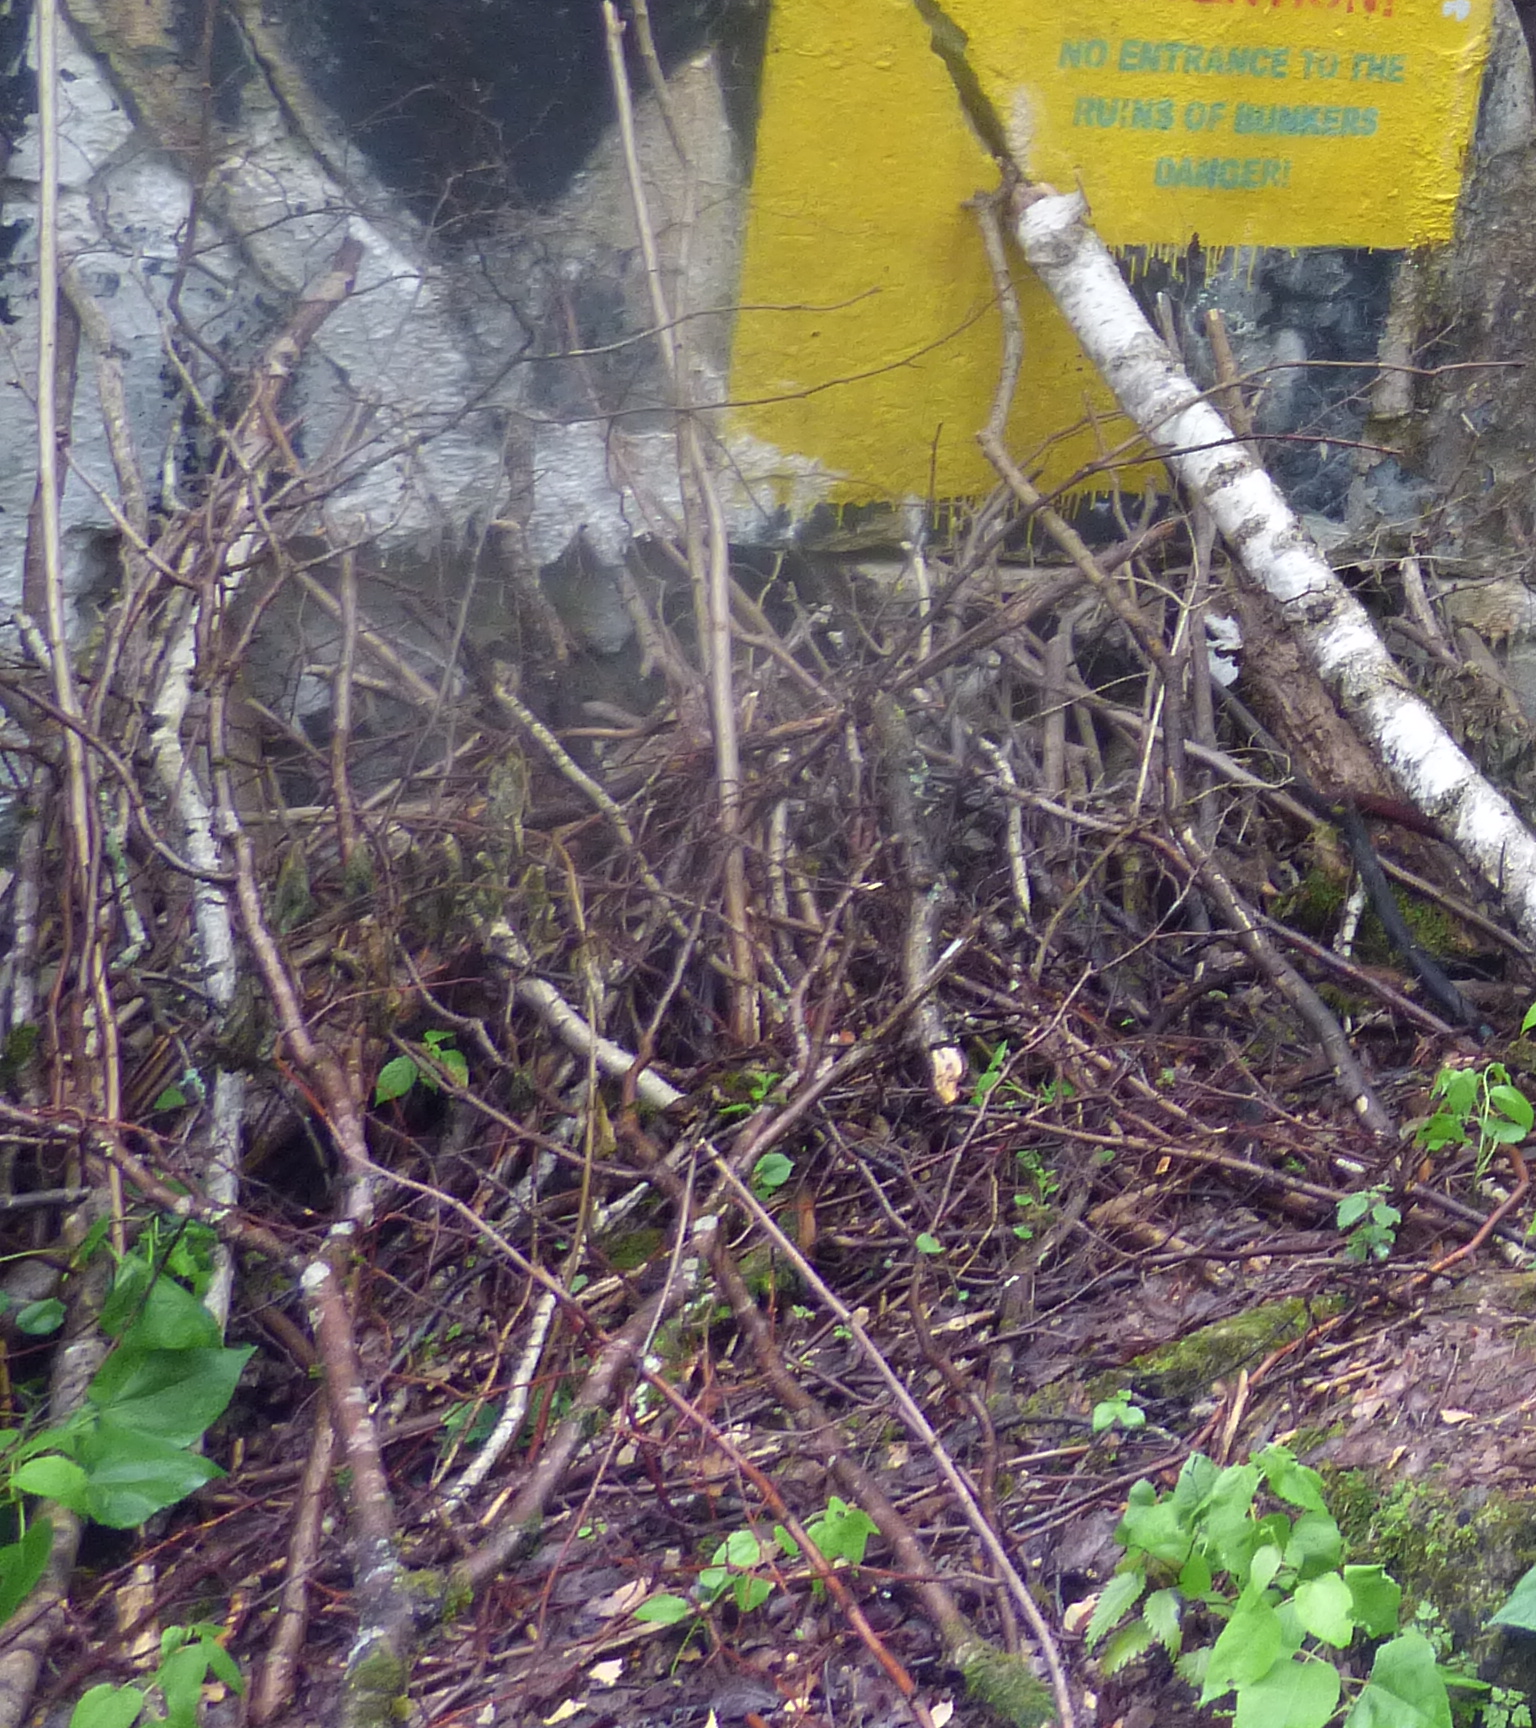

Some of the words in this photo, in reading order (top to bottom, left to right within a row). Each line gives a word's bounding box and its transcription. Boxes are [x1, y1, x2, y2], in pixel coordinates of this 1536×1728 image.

[1058, 38, 1109, 69] NO
[1118, 38, 1291, 80] ENTRANCE
[1301, 48, 1340, 80] TO
[1351, 52, 1408, 84] THE
[1072, 96, 1175, 131] RUINS
[1184, 100, 1227, 132] OF
[1233, 101, 1380, 137] BUNKERS
[1153, 155, 1293, 191] DANGER!
